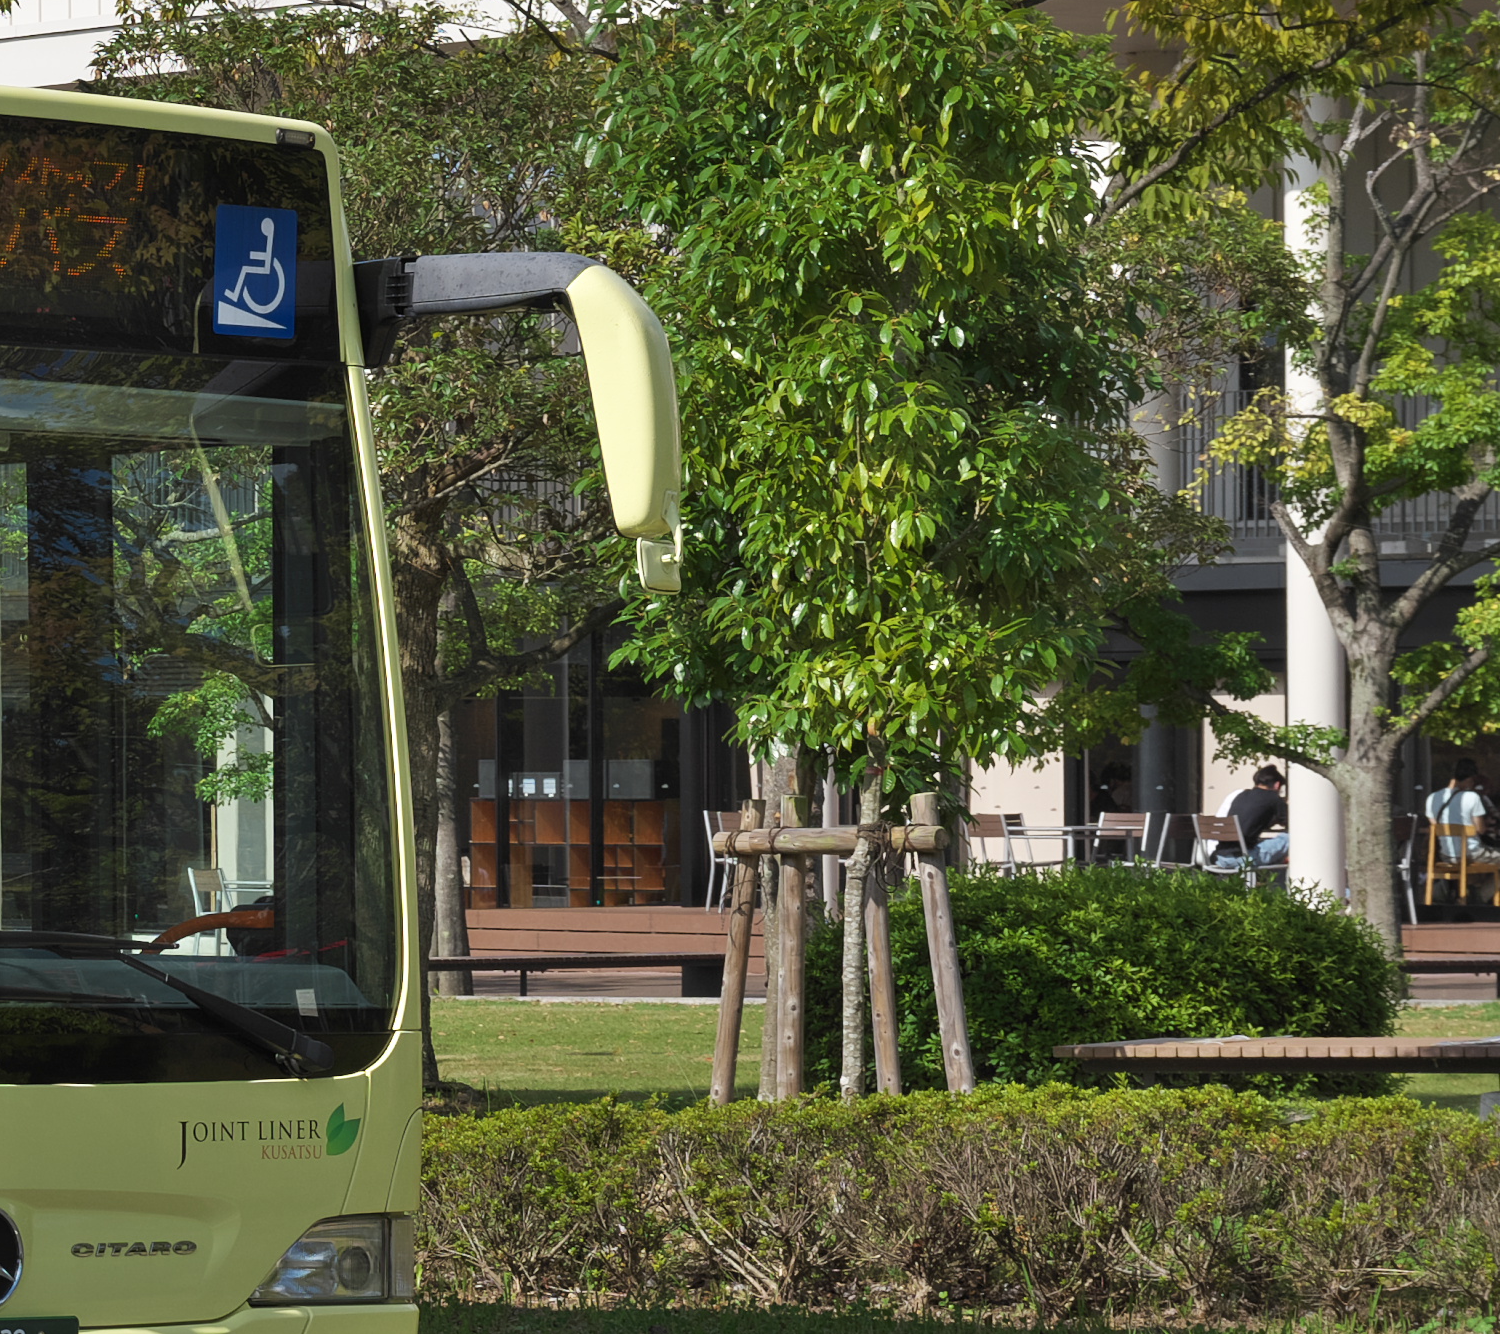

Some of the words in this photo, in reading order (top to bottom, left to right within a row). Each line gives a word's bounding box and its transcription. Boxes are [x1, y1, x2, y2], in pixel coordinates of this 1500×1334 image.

[176, 1120, 250, 1170] JOINT
[257, 1119, 322, 1142] LINER
[260, 1144, 323, 1160] KUSATSU
[70, 1240, 198, 1259] CITARO
